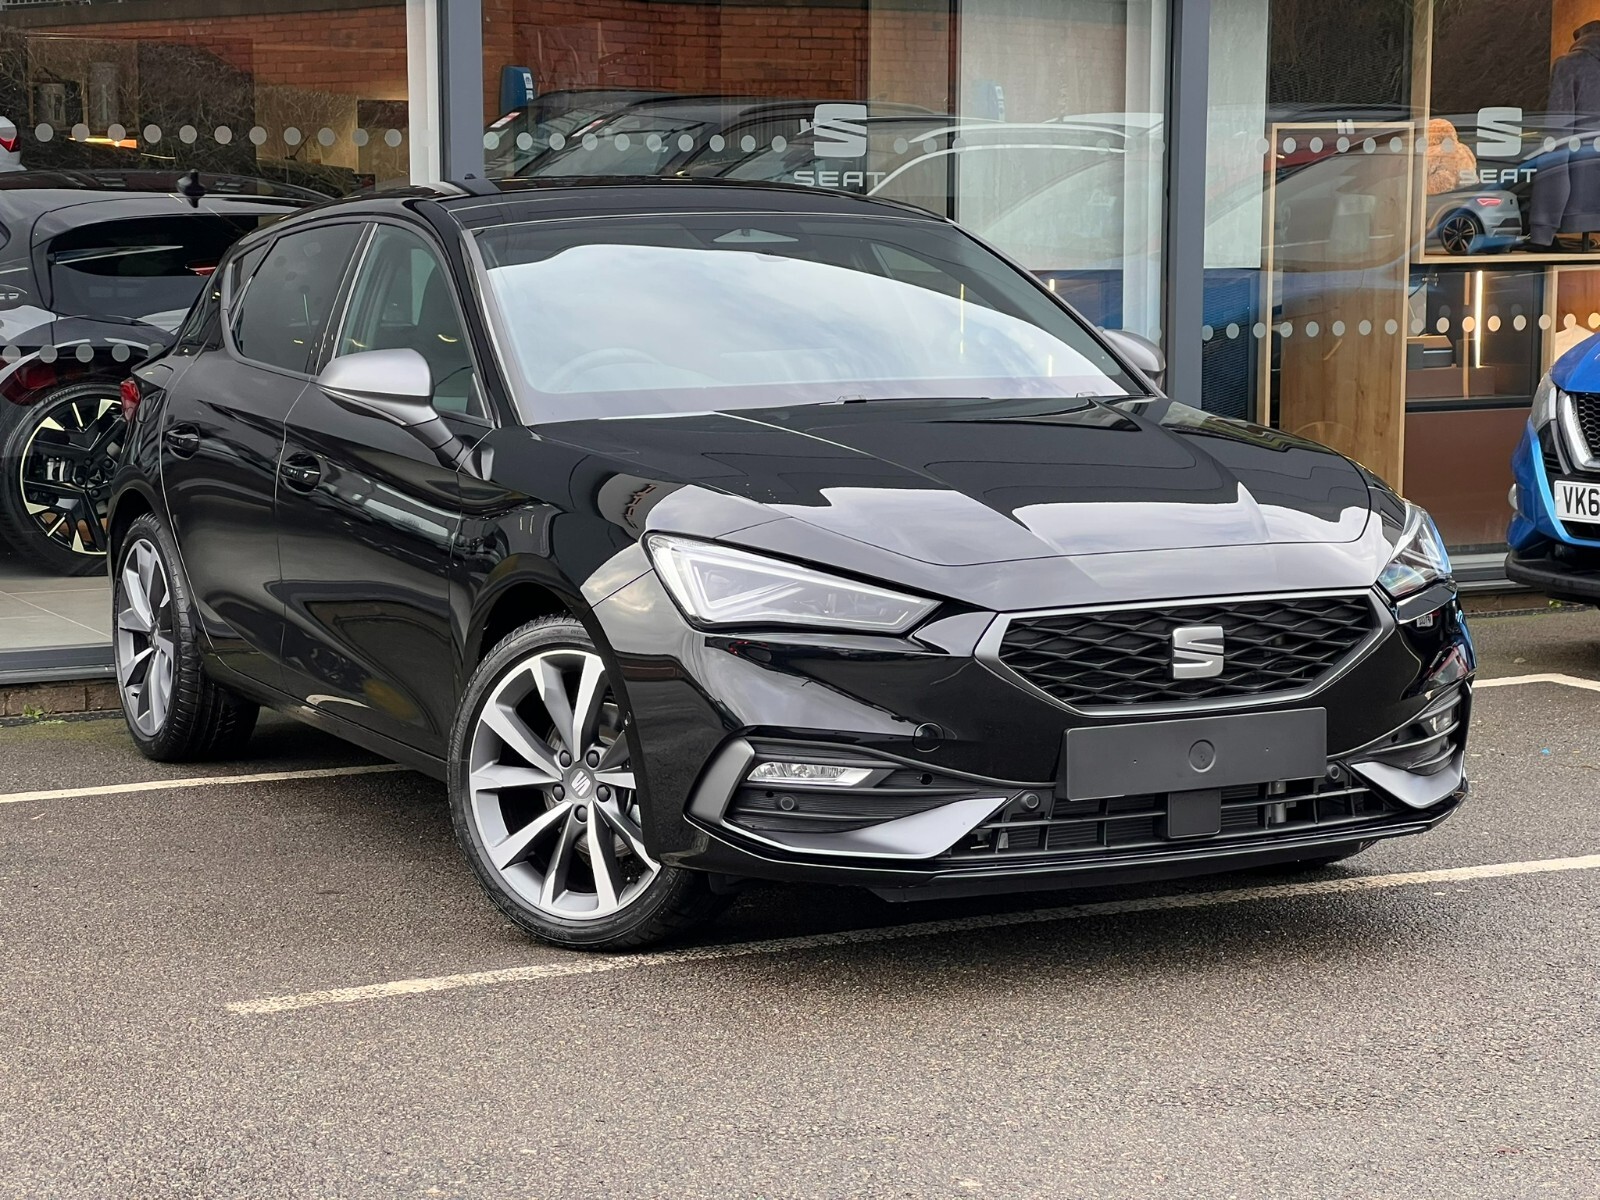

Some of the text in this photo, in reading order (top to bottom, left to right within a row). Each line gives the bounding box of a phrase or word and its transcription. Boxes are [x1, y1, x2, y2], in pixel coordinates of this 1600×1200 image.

[794, 171, 886, 187] SEAT
[1459, 169, 1537, 184] SEAT
[1563, 486, 1600, 516] VK6
